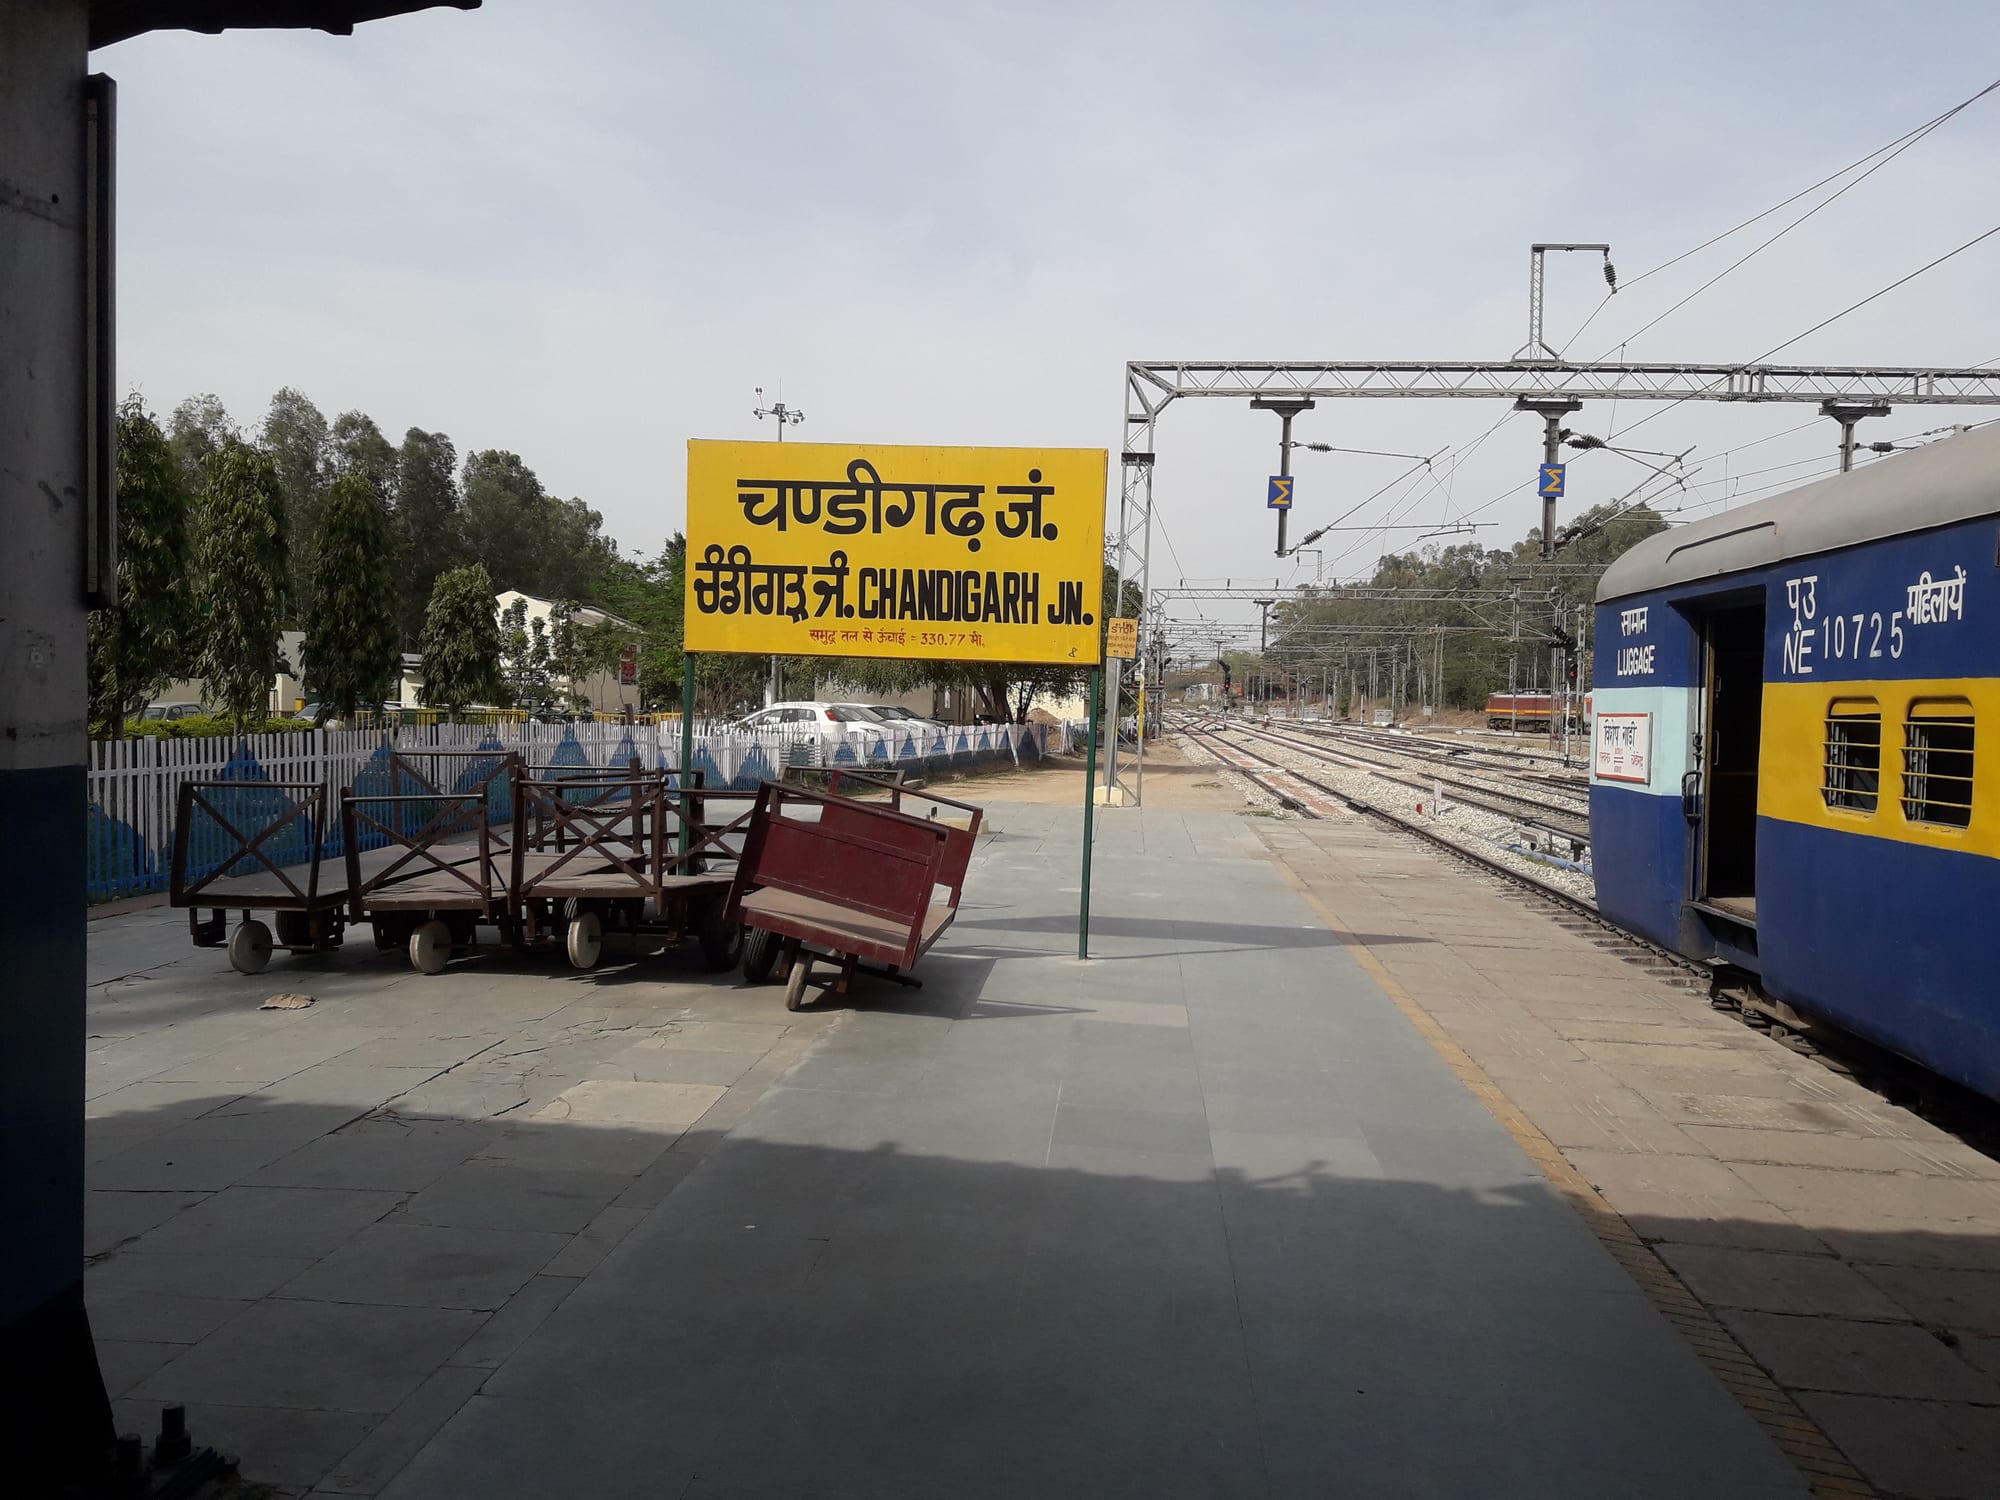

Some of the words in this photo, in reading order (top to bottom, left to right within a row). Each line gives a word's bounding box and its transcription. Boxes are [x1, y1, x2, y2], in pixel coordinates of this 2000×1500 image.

[736, 458, 986, 553] चण्डीगढ़
[995, 468, 1059, 541] जं.
[858, 566, 1039, 626] CHANDIGARH
[1047, 580, 1094, 626] JN.
[1620, 606, 1649, 638] सामान
[1906, 564, 1967, 625] महिलायें
[840, 630, 860, 642] तल
[863, 627, 874, 643] से
[920, 632, 966, 646] 330.77
[1617, 643, 1656, 677] LUGGAGE
[1783, 628, 1816, 675] NE
[1822, 610, 1904, 660] 10725
